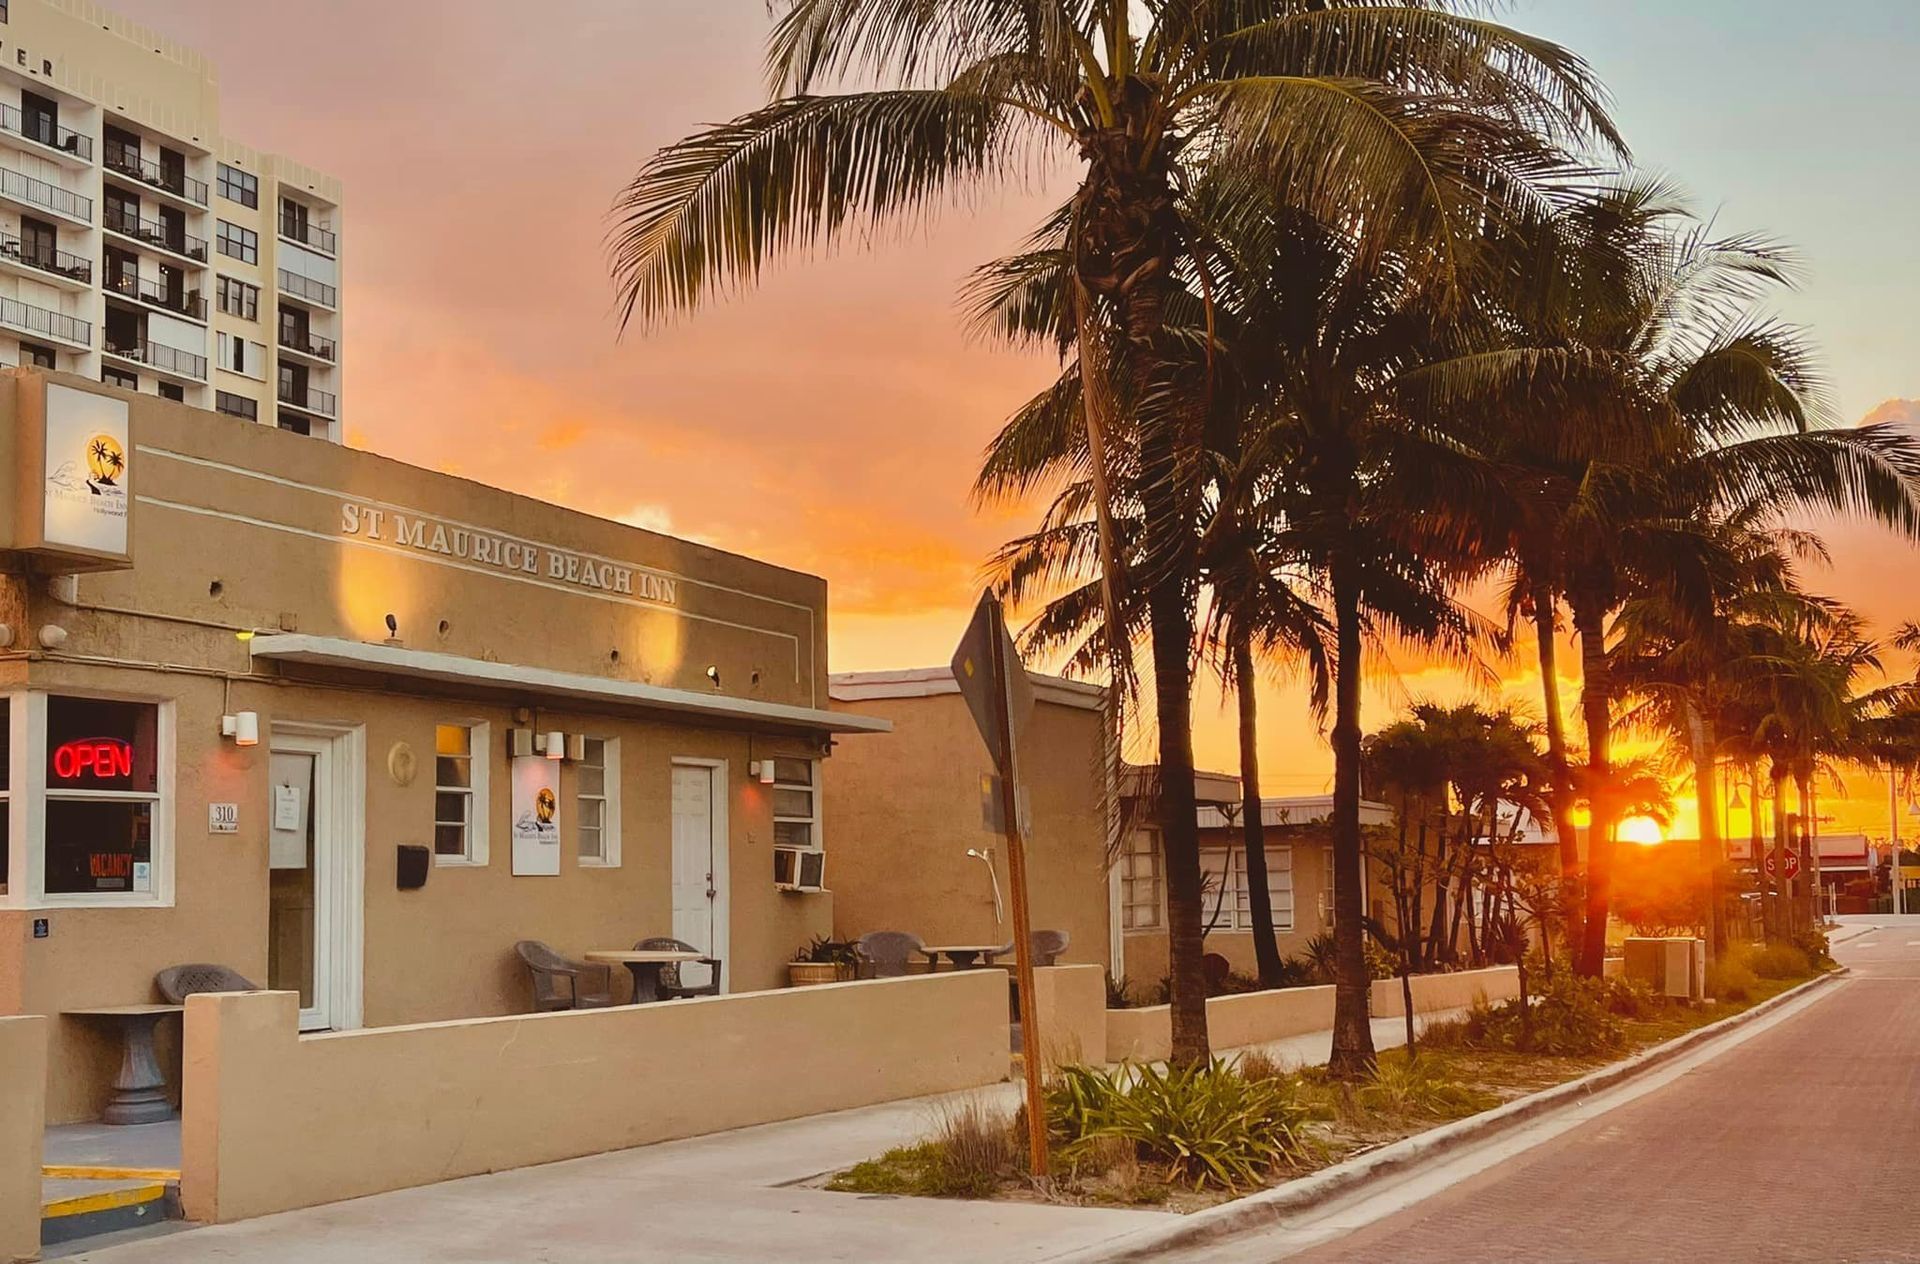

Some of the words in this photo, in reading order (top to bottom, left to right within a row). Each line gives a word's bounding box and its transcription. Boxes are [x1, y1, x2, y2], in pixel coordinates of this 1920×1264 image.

[0, 41, 52, 77] ER
[394, 515, 538, 575] MAURICE
[547, 552, 633, 595] BEACH
[640, 574, 677, 605] INN
[54, 744, 131, 778] OPEN
[216, 806, 234, 821] 310
[90, 853, 133, 877] VACANCY
[1767, 858, 1797, 871] SOP
